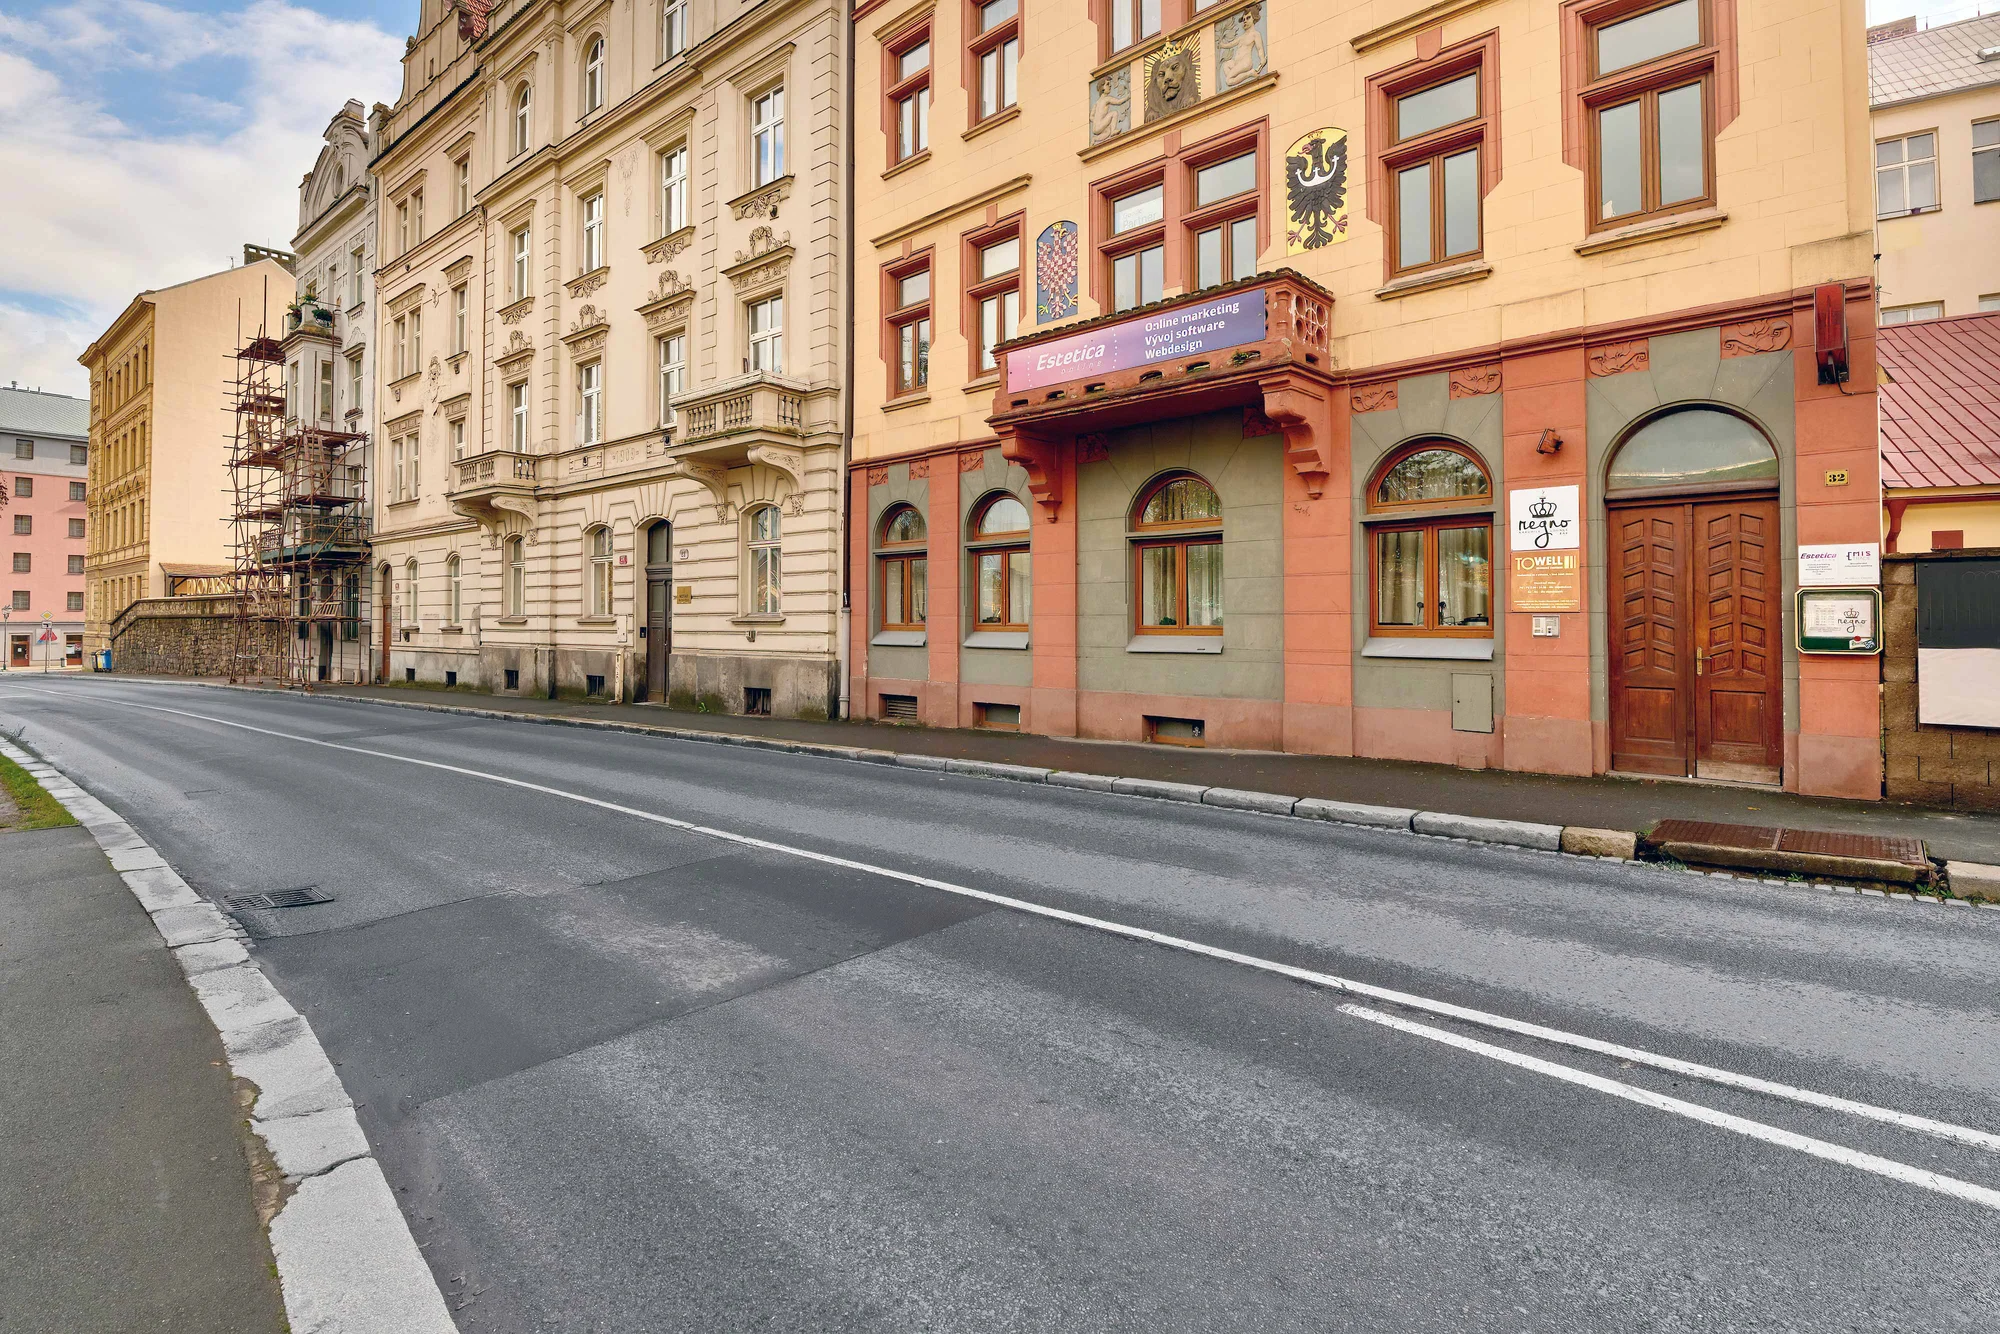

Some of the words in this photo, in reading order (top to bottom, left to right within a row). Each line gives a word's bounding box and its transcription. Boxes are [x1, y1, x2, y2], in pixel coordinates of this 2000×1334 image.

[1145, 317, 1179, 332] Online
[1181, 302, 1240, 324] marketing
[1145, 330, 1174, 346] Vývoj
[1176, 320, 1225, 339] software
[1036, 344, 1106, 371] Estetica
[1145, 340, 1203, 359] Webdesign
[1061, 361, 1103, 375] online
[1829, 473, 1846, 483] 32
[1518, 519, 1572, 549] regno
[1515, 556, 1563, 571] TOWELL
[1800, 552, 1837, 560] Estetica
[1837, 618, 1868, 633] regno
